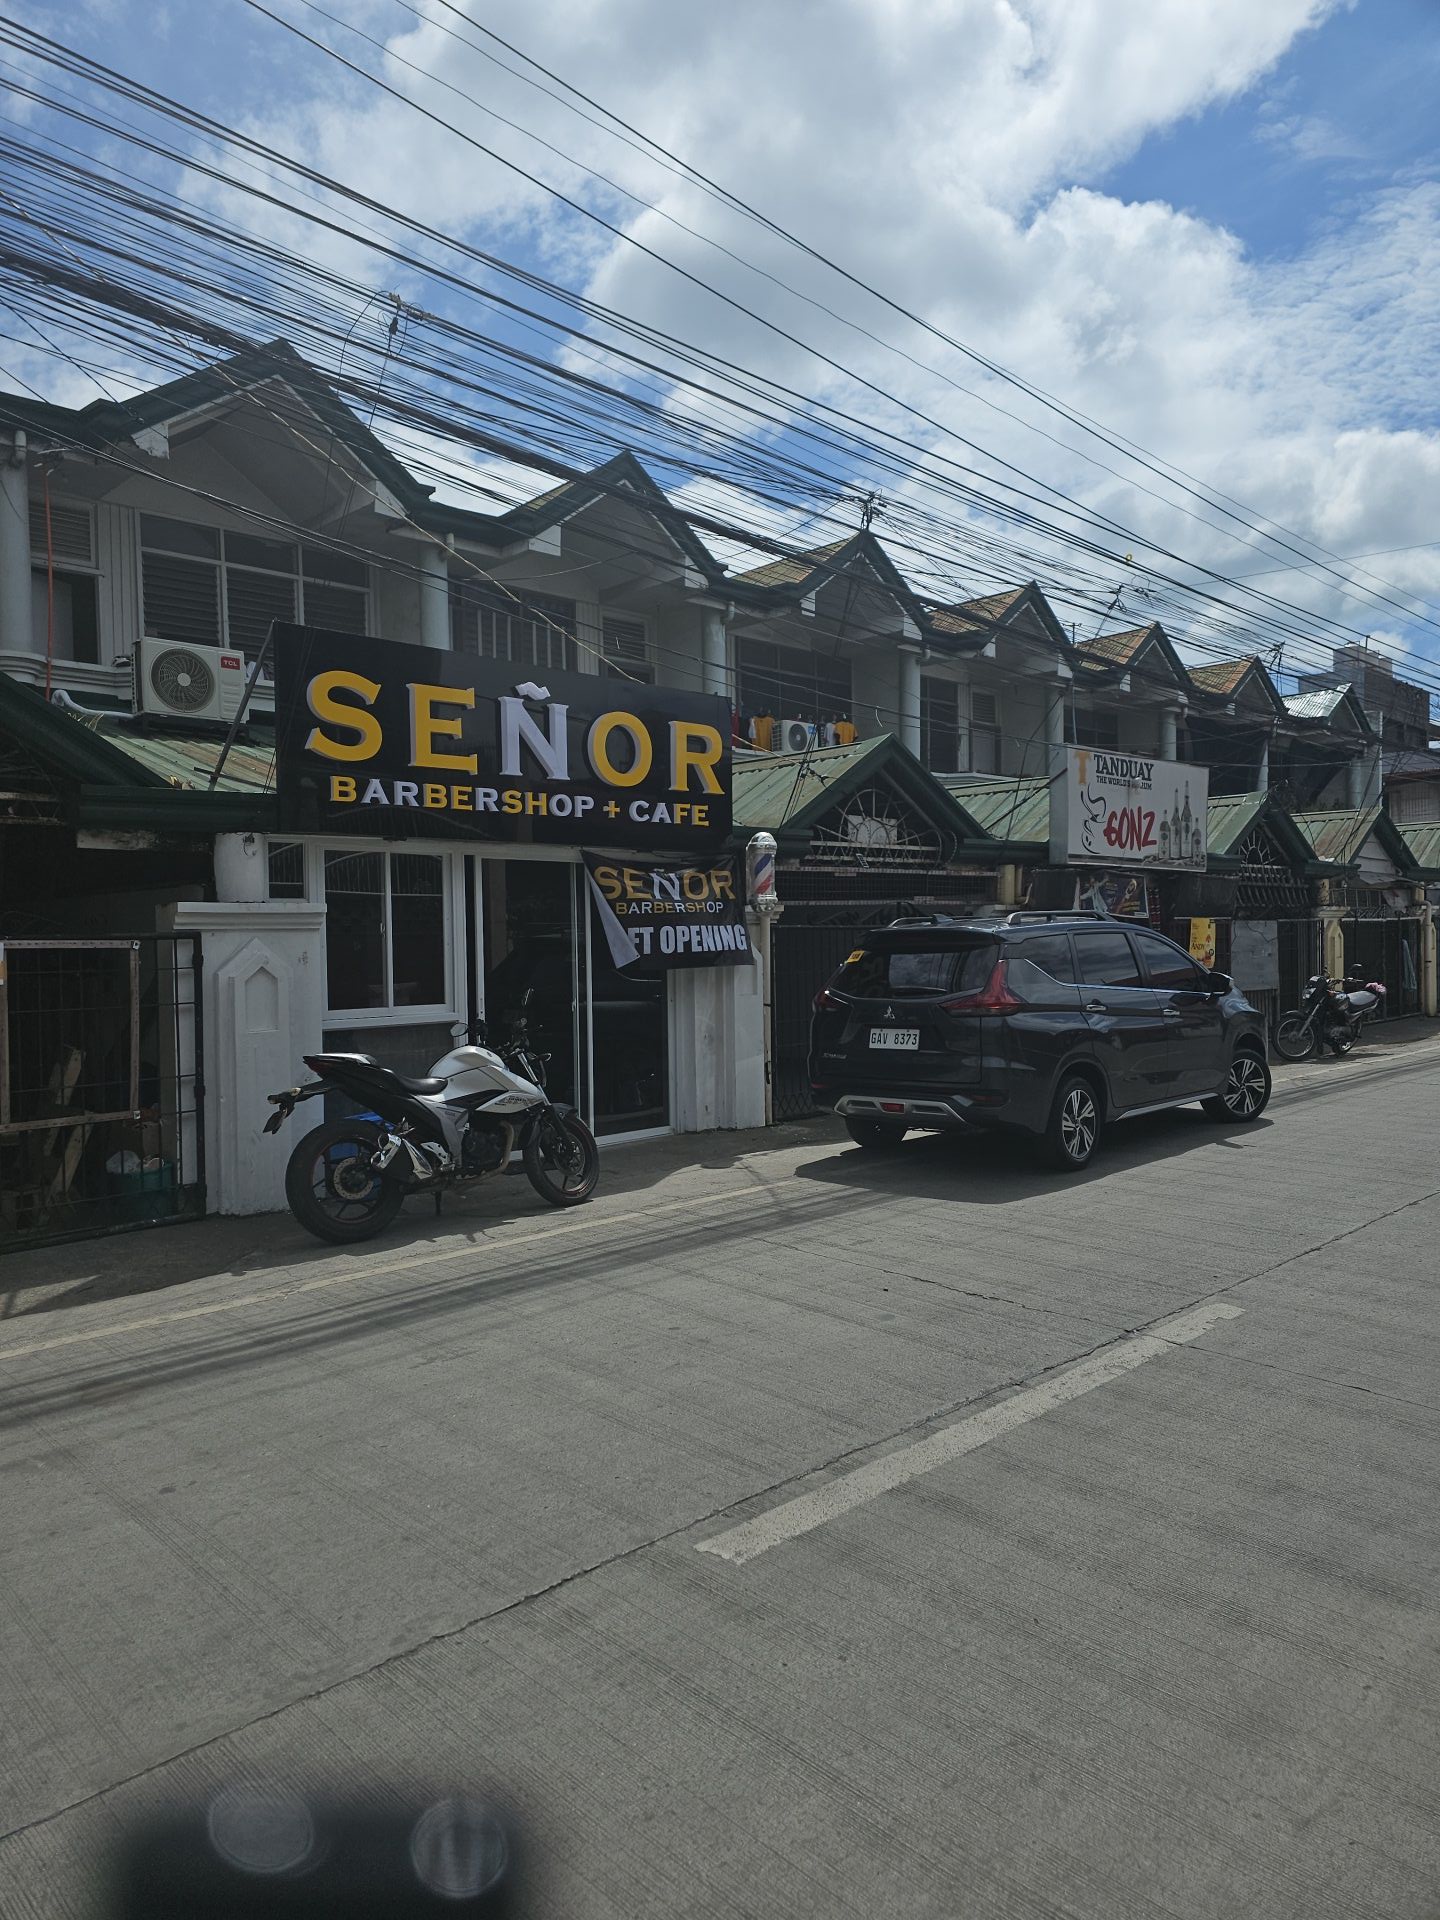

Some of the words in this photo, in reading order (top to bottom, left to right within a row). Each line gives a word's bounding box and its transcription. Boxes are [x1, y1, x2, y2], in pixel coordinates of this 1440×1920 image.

[223, 659, 238, 667] TCL
[304, 670, 726, 795] SEÑOR
[1094, 753, 1154, 782] TANDUAY
[1096, 775, 1107, 785] THE
[329, 775, 595, 818] BARBERSHOP
[628, 800, 710, 827] CAFE
[593, 866, 737, 901] SEÑOR
[615, 901, 724, 915] BARBERSHOP
[627, 926, 655, 955] FT
[660, 923, 748, 954] OPENING
[871, 1032, 889, 1045] GAV
[894, 1033, 918, 1046] 8373
